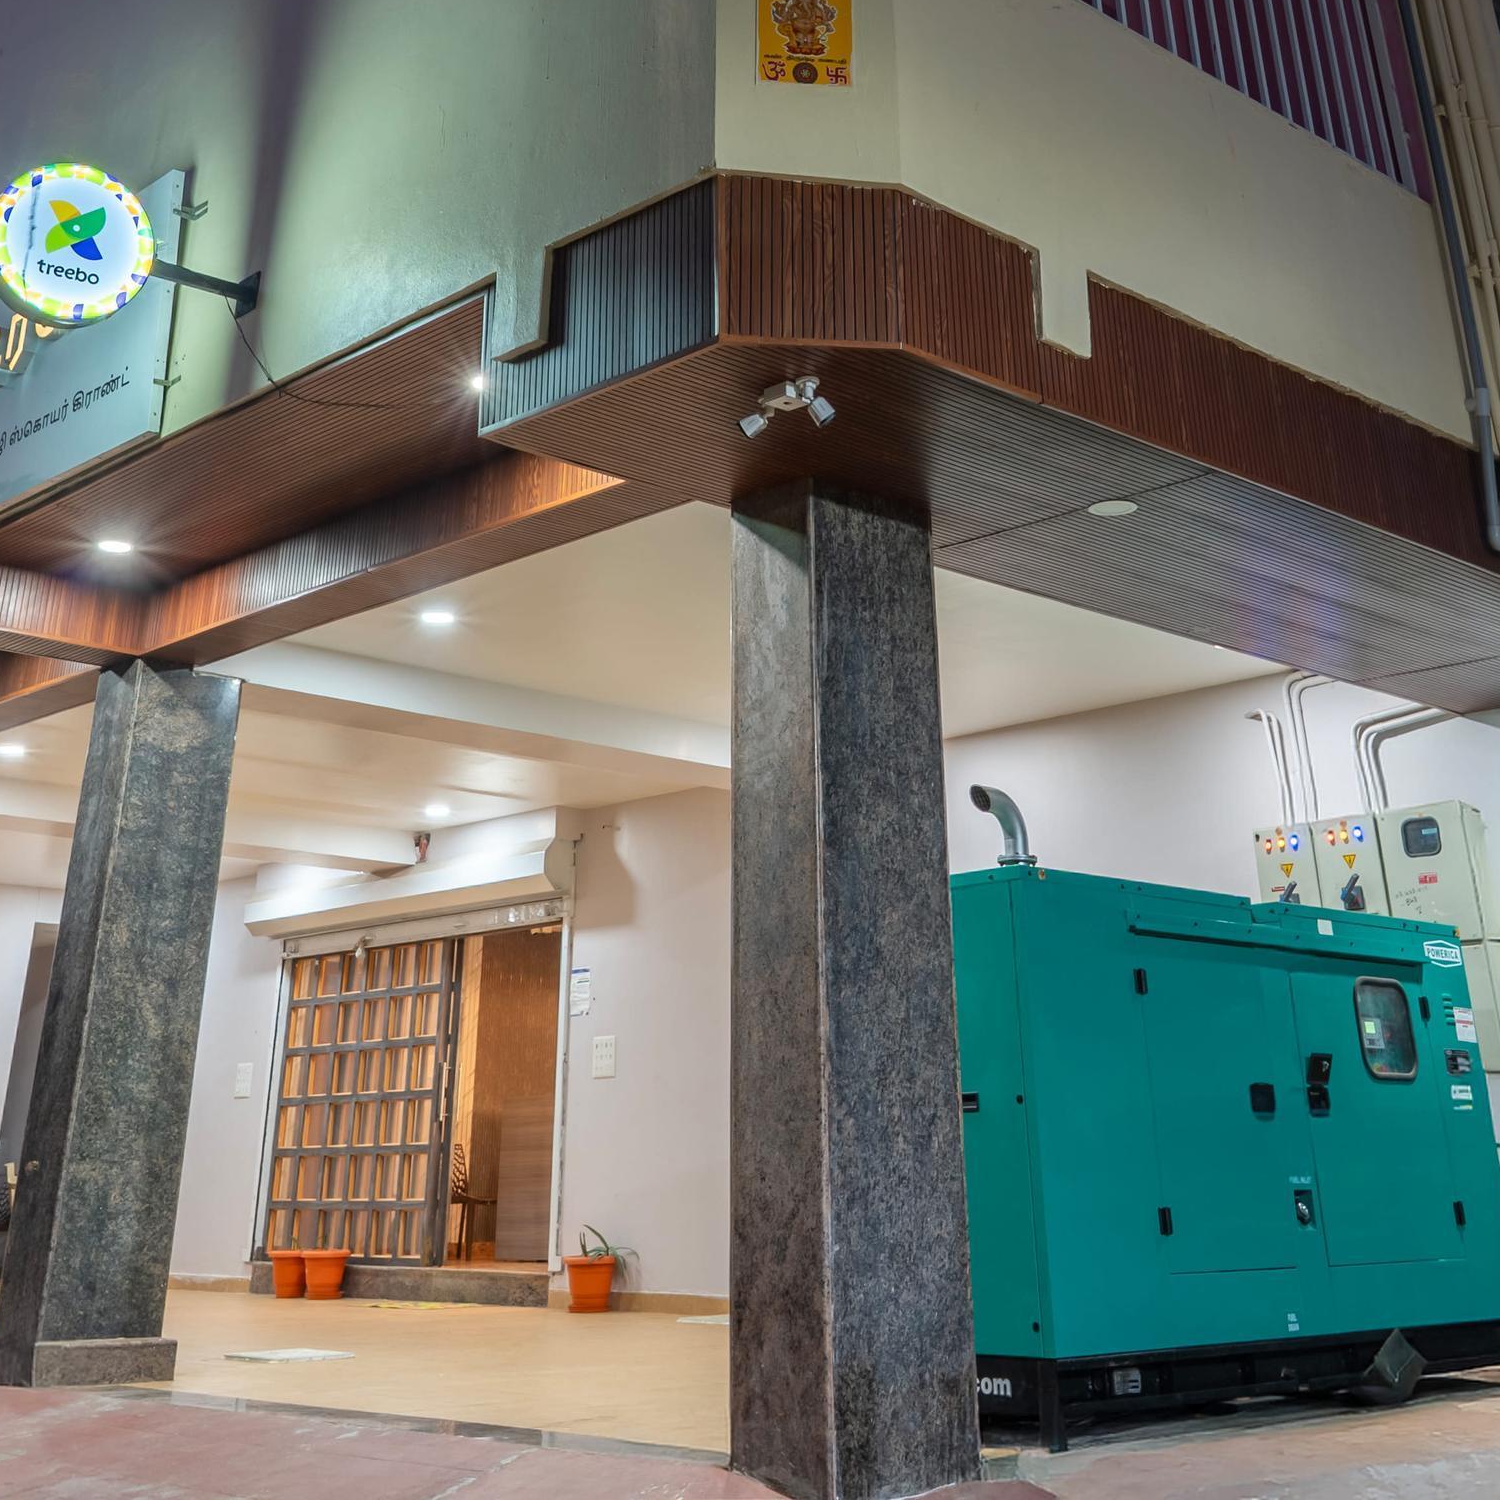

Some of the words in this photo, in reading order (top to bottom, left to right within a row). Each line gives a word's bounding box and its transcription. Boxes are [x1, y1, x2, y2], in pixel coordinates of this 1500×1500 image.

[37, 259, 100, 285] treebo
[9, 398, 69, 447] ஸ்கொயர்
[1426, 947, 1460, 960] POWERICA
